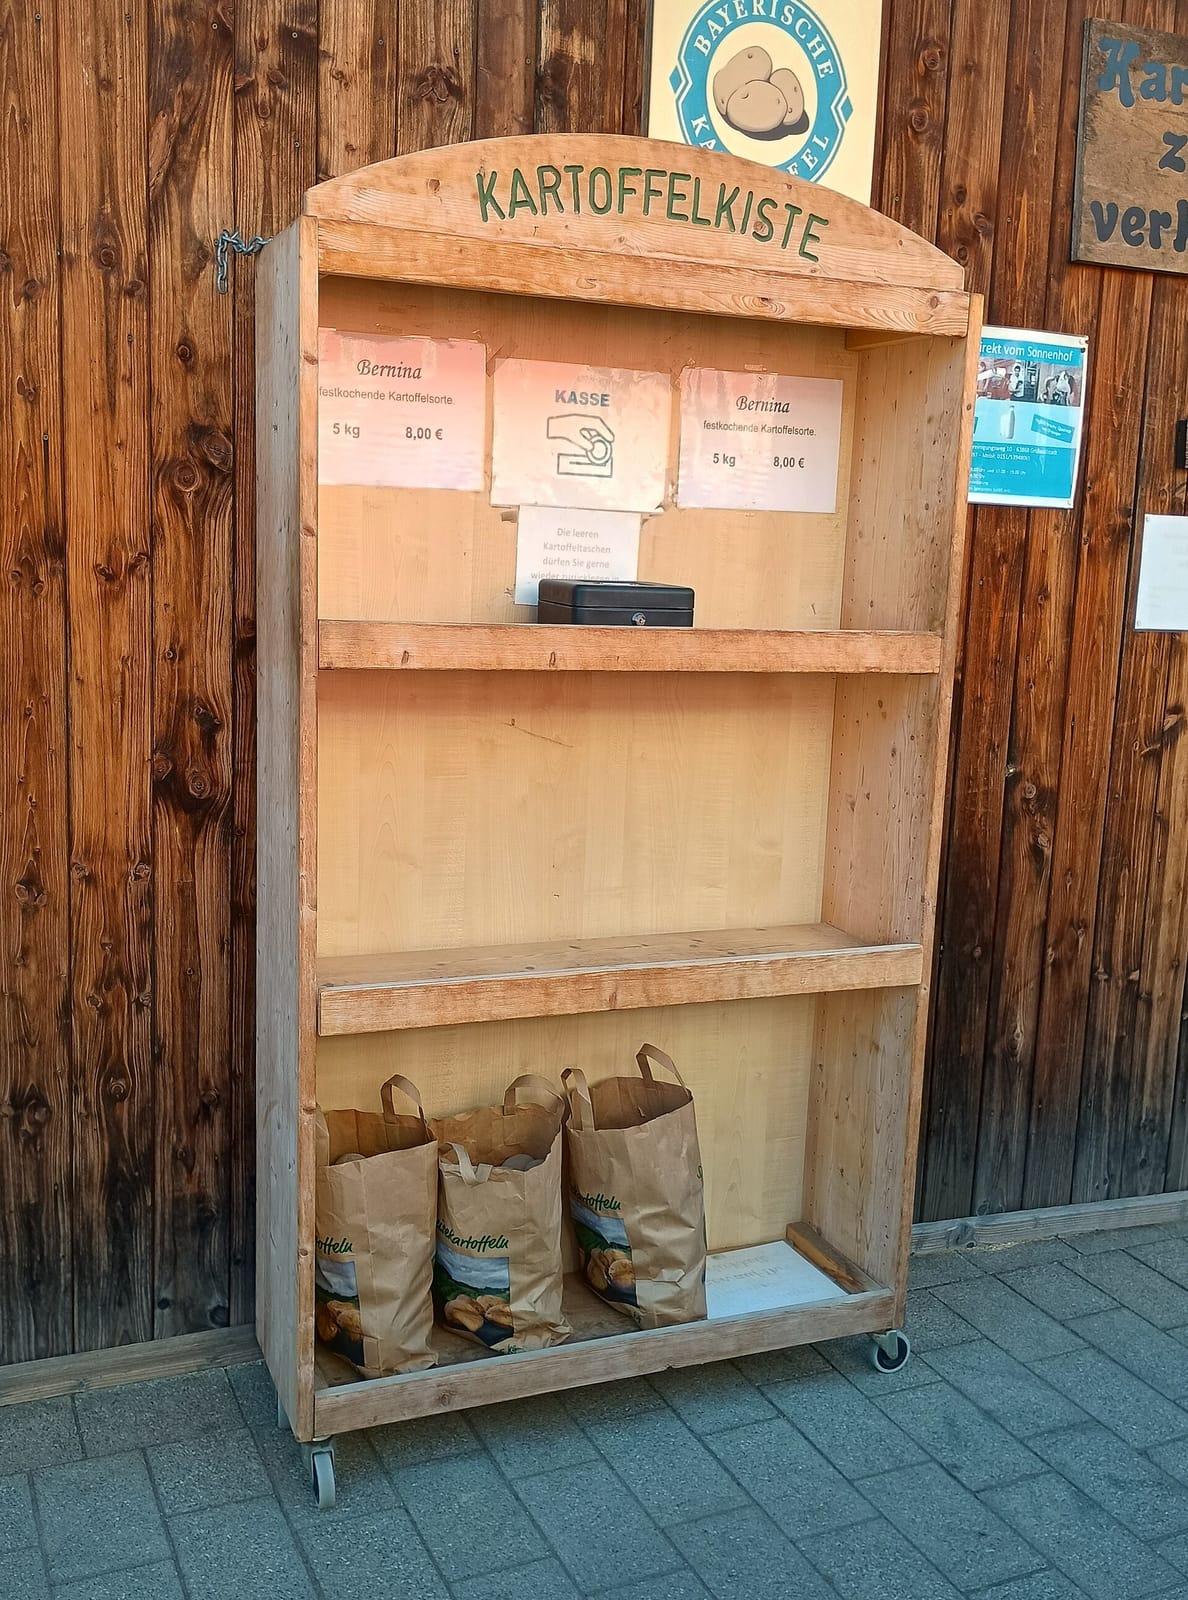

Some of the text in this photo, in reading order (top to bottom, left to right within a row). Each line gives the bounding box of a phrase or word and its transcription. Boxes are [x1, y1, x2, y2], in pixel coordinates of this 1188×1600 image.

[693, 0, 834, 79] BAYERISCHE
[476, 165, 829, 262] KARTOFFELKISTE
[1003, 346, 1025, 357] vom
[357, 359, 422, 380] Bernina
[319, 387, 455, 405] festkochende Kartoffelsorte.
[555, 389, 610, 407] KASSE
[736, 395, 790, 414] Bernina
[332, 423, 443, 440] 5 kg 8,00 €
[703, 420, 817, 437] festkochende Kartoffelsorte.
[713, 453, 805, 468] 5 kg 8,00 €
[557, 527, 598, 539] Die leeren
[543, 541, 611, 554] Kartoffeltaschen
[543, 557, 610, 570] dürfen Sie gerne
